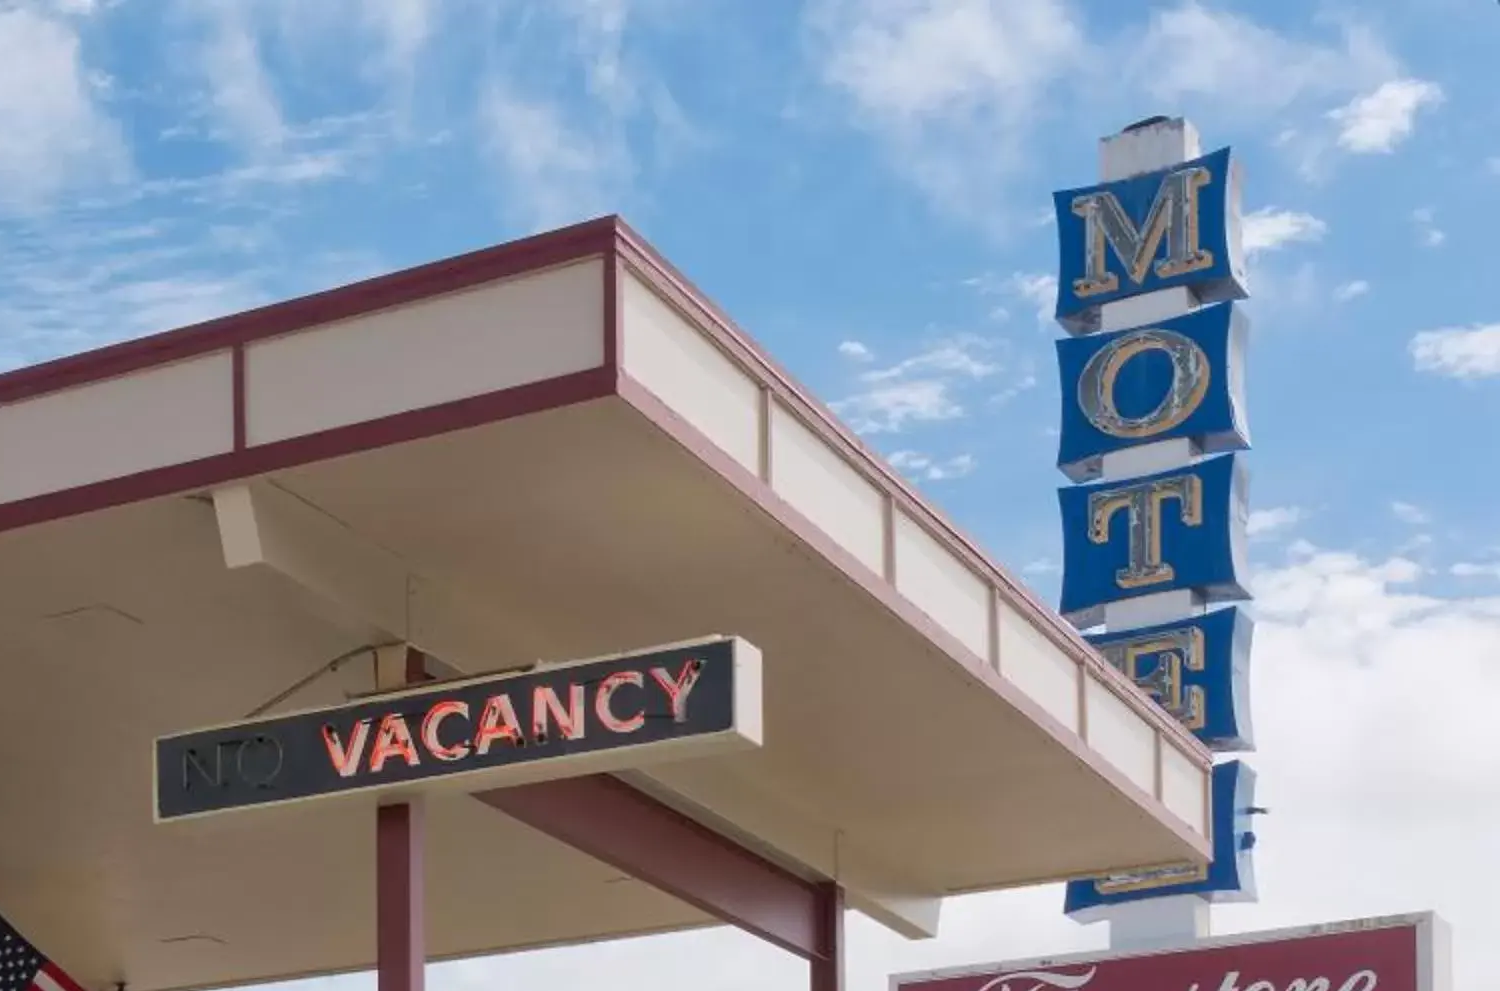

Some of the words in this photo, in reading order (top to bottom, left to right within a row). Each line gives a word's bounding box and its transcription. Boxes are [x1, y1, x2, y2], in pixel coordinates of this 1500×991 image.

[182, 734, 284, 791] NO
[322, 658, 709, 778] VACANCY
[1071, 165, 1214, 893] MOTE
